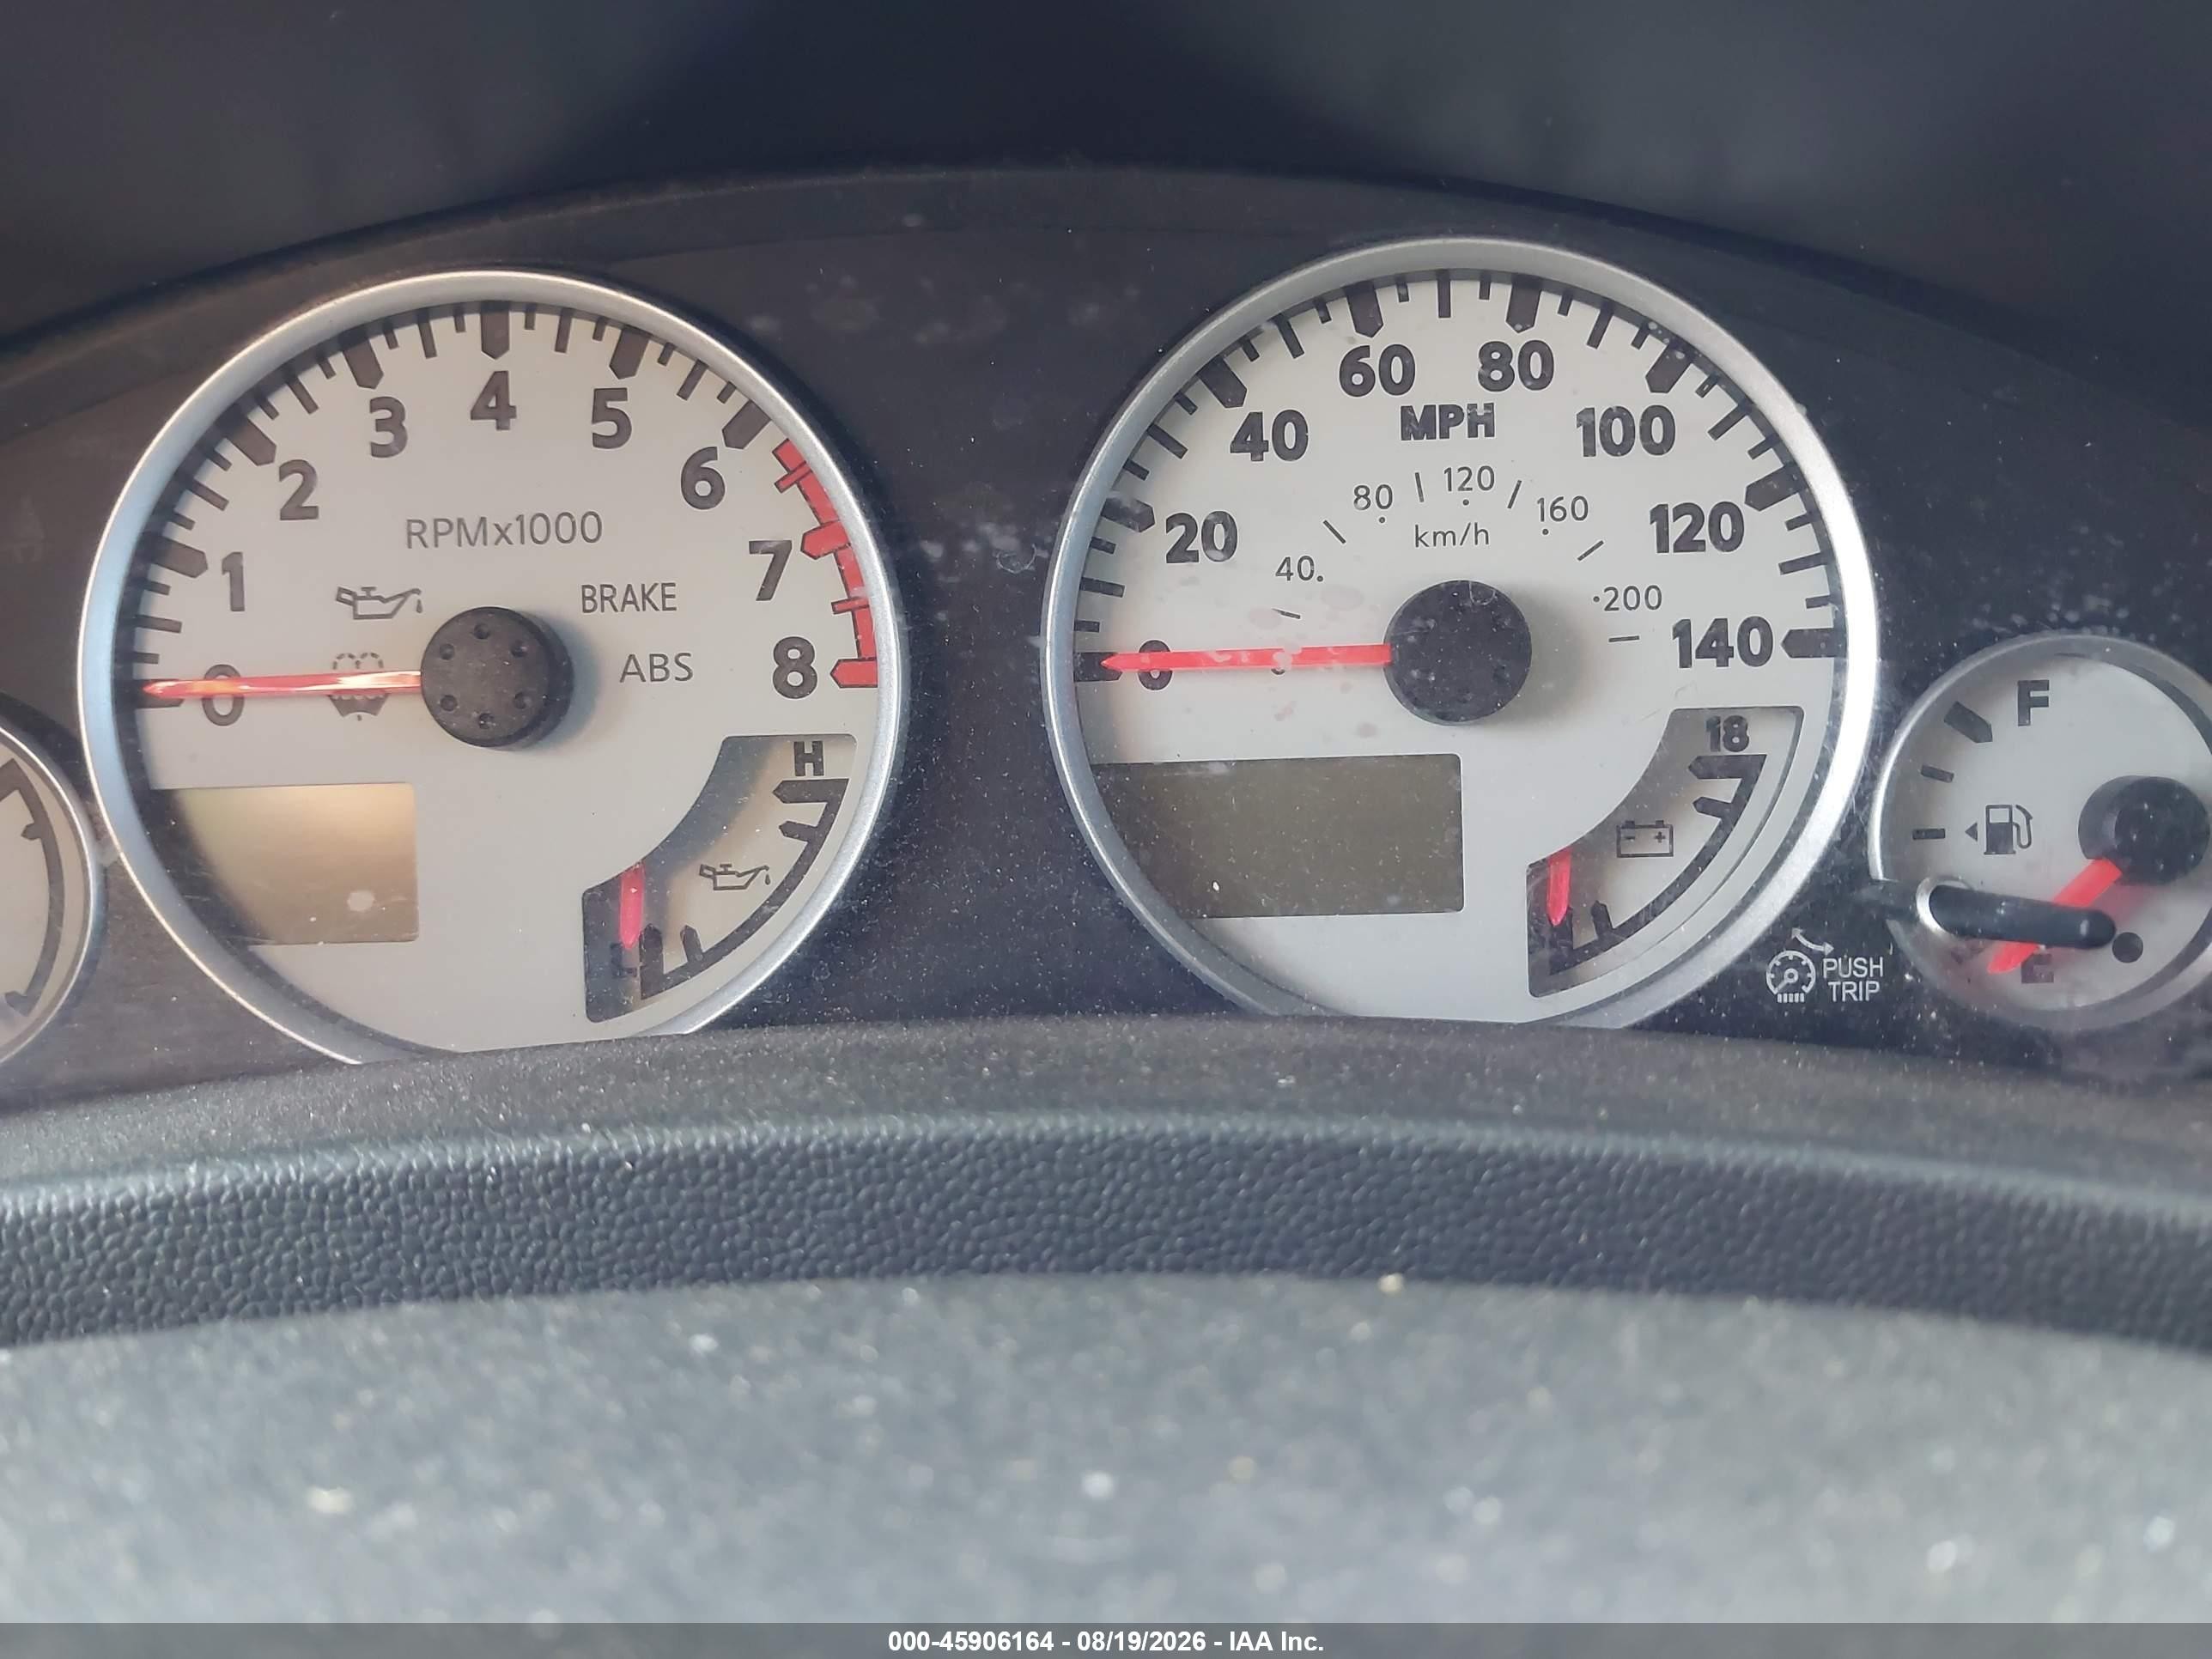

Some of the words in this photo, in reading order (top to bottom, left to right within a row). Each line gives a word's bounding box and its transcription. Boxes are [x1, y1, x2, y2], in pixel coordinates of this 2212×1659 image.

[1340, 344, 1415, 397] 60
[1478, 340, 1554, 392] 80
[471, 371, 516, 430] 4
[592, 387, 632, 449] 5
[1401, 403, 1494, 441] MPH
[369, 397, 407, 458] 3
[1230, 410, 1308, 461] 40
[1577, 405, 1675, 457] 100
[279, 459, 319, 520] 2
[681, 447, 726, 509] 6
[1354, 484, 1392, 510] 80
[1444, 466, 1494, 491] 120
[407, 511, 602, 549] RPMx1000
[1537, 496, 1588, 521] 160
[1650, 501, 1744, 553] 120
[1166, 511, 1237, 563] 20
[1415, 522, 1488, 547] km/h
[222, 552, 245, 611] 1
[749, 540, 792, 601] 7
[1276, 556, 1314, 580] 40
[581, 583, 677, 613] BRAKE
[1604, 586, 1662, 611] 200
[773, 636, 817, 699] 8
[1137, 640, 1171, 690] 0
[1673, 617, 1773, 668] 140
[619, 653, 692, 683] ABS
[202, 664, 244, 726] 0
[2017, 679, 2050, 726] F
[793, 740, 823, 776] H
[1706, 715, 1749, 752] 18
[1823, 957, 1883, 978] PUSH
[1828, 981, 1881, 1002] TRIP
